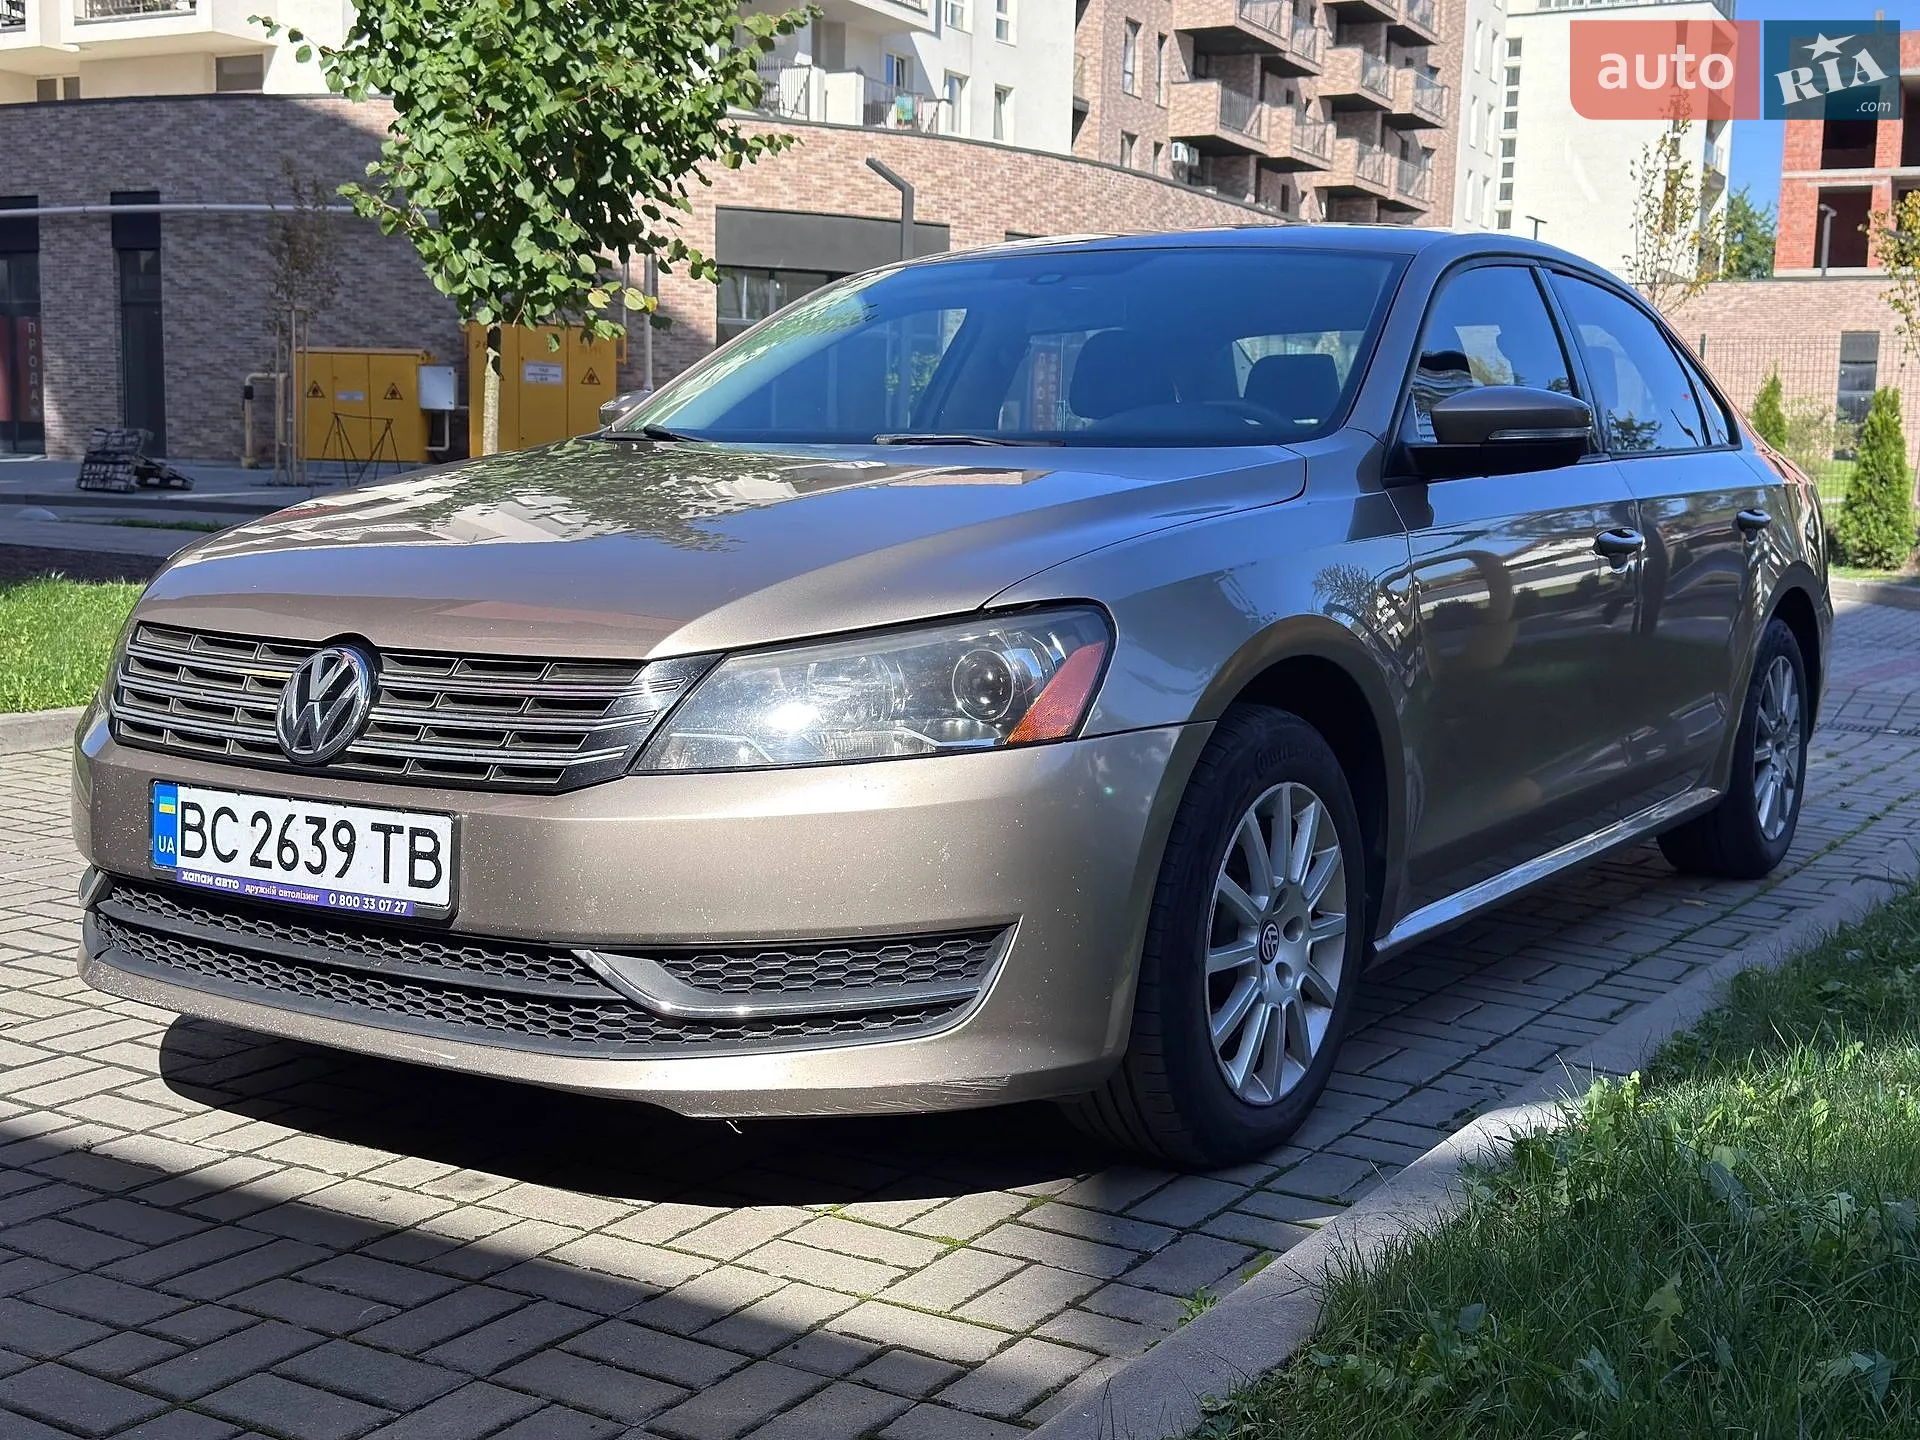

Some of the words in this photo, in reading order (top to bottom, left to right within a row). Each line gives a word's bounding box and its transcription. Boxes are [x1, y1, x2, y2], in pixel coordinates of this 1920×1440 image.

[158, 834, 176, 855] UA
[250, 810, 356, 879] 2639
[370, 822, 443, 890] TB
[329, 893, 337, 905] 0
[339, 894, 360, 908] 800
[362, 897, 376, 910] 33
[378, 900, 392, 912] 07
[394, 901, 407, 914] 27
